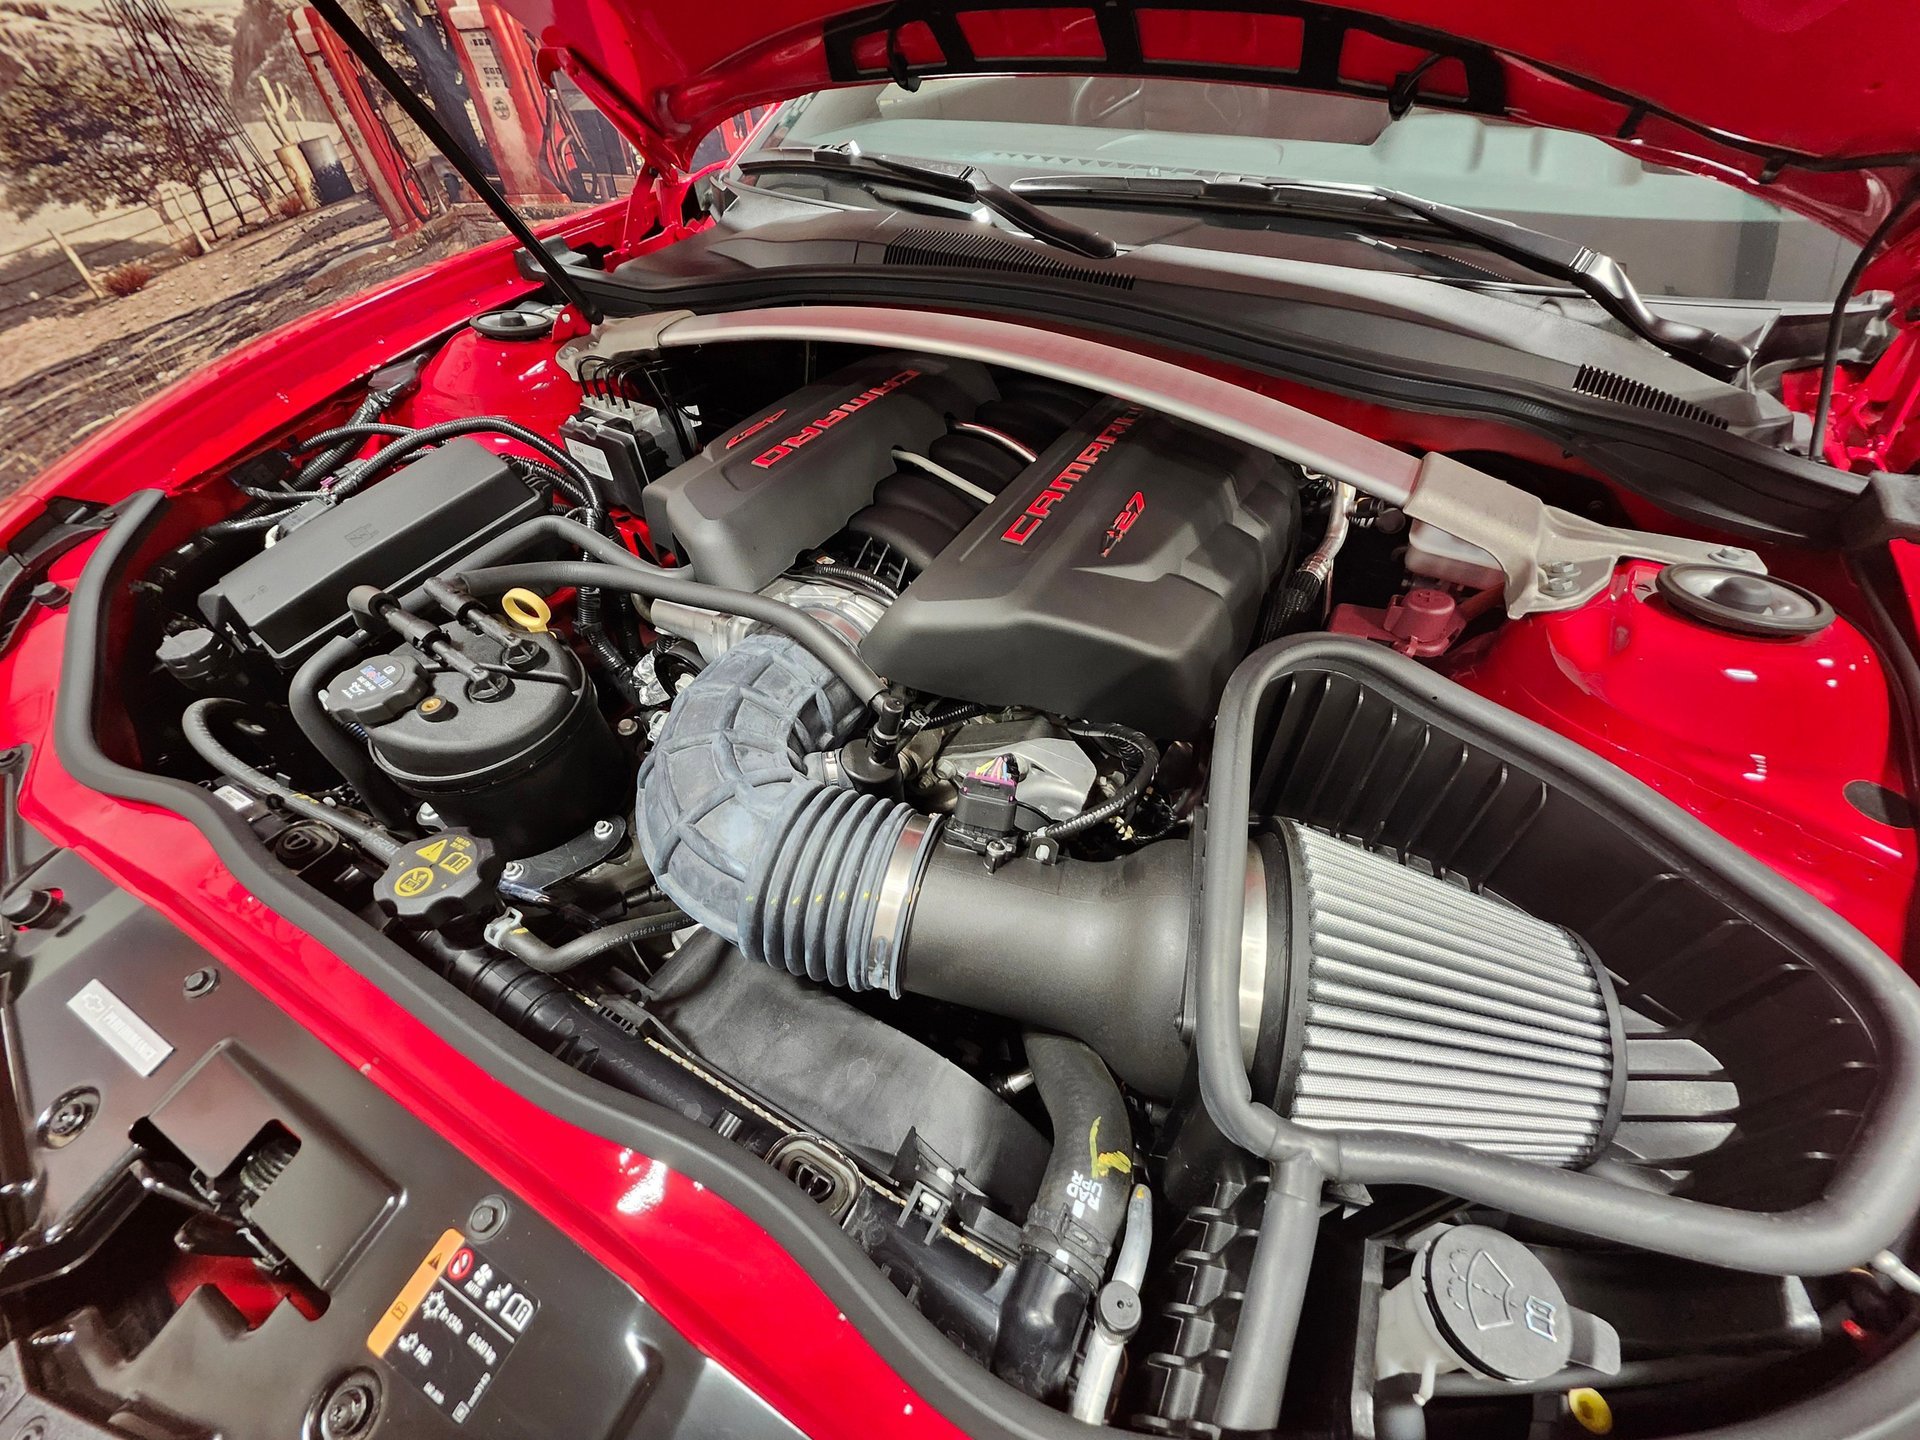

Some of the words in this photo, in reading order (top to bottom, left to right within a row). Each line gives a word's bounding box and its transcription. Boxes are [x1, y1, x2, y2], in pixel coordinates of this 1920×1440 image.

[726, 409, 788, 449] 427
[752, 370, 922, 469] CAMARO
[1001, 406, 1144, 546] CAMARO
[1099, 490, 1147, 558] 427
[1066, 1183, 1100, 1211] RAD
[1071, 1170, 1103, 1197] UPR
[464, 1280, 483, 1299] AUTO
[439, 1307, 463, 1335] R-134a
[413, 1343, 433, 1367] PAG
